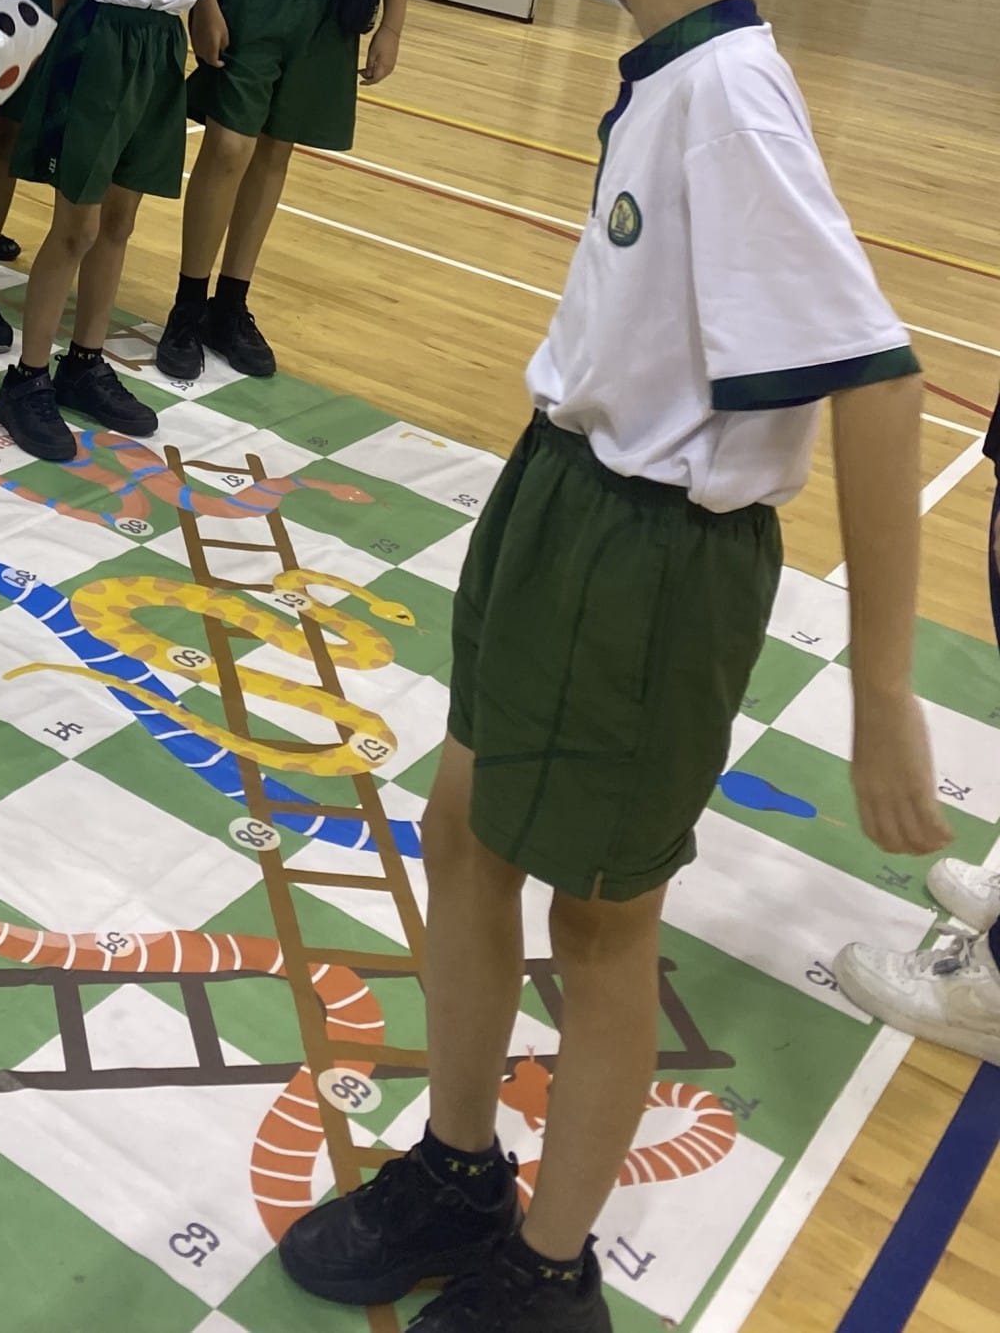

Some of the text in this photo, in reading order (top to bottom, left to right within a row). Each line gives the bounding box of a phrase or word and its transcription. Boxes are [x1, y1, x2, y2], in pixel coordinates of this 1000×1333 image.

[222, 474, 245, 488] 37
[119, 519, 149, 534] 38
[370, 538, 401, 554] 52
[3, 569, 38, 587] 39
[273, 592, 308, 609] 51
[172, 649, 206, 668] 50
[43, 720, 84, 742] 49
[357, 738, 390, 763] 57
[234, 820, 274, 848] 58
[95, 930, 130, 957] 59
[167, 1221, 222, 1269] 65
[606, 1235, 657, 1282] 77
